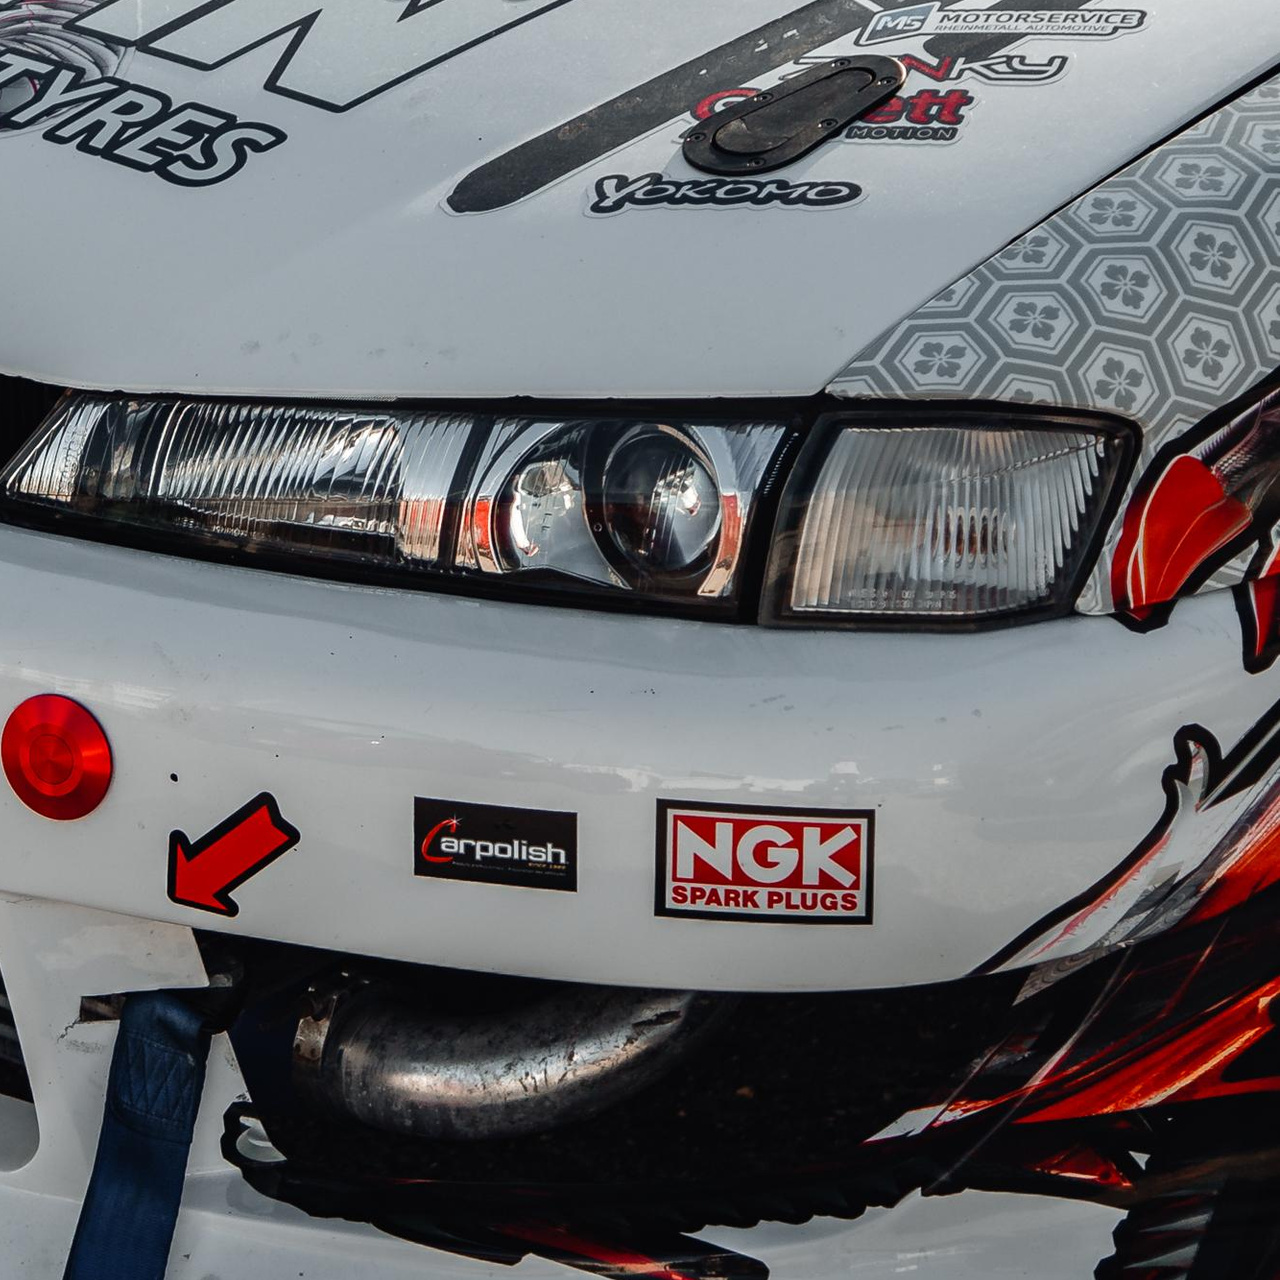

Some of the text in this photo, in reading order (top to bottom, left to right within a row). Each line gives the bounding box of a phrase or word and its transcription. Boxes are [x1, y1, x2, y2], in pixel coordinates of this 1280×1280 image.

[934, 24, 1109, 32] RHEINMETALL AUTOMOTIVE
[938, 12, 1137, 25] MOTORSERVICE
[850, 128, 955, 139] MOTION
[597, 175, 853, 208] YOKOMO
[421, 818, 569, 865] Carpolish
[676, 820, 858, 888] NGK
[671, 885, 858, 912] SPARK PLUGS
